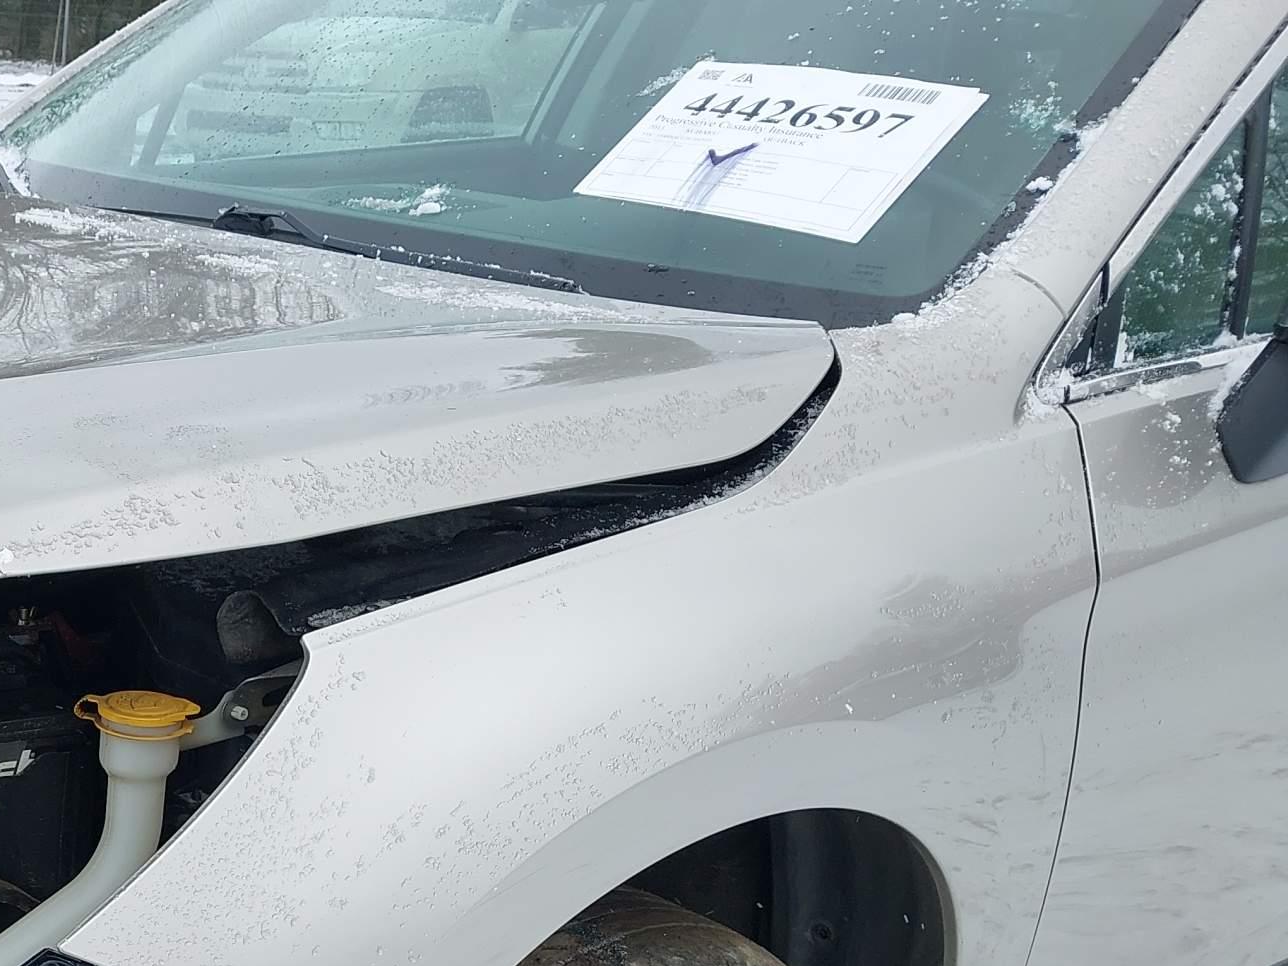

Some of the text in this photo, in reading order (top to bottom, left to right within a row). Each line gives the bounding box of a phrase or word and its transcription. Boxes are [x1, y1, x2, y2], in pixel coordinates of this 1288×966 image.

[654, 114, 717, 129] Progressive
[718, 120, 763, 135] Casualty
[768, 125, 824, 140] Insurance
[683, 93, 916, 138] 44426597
